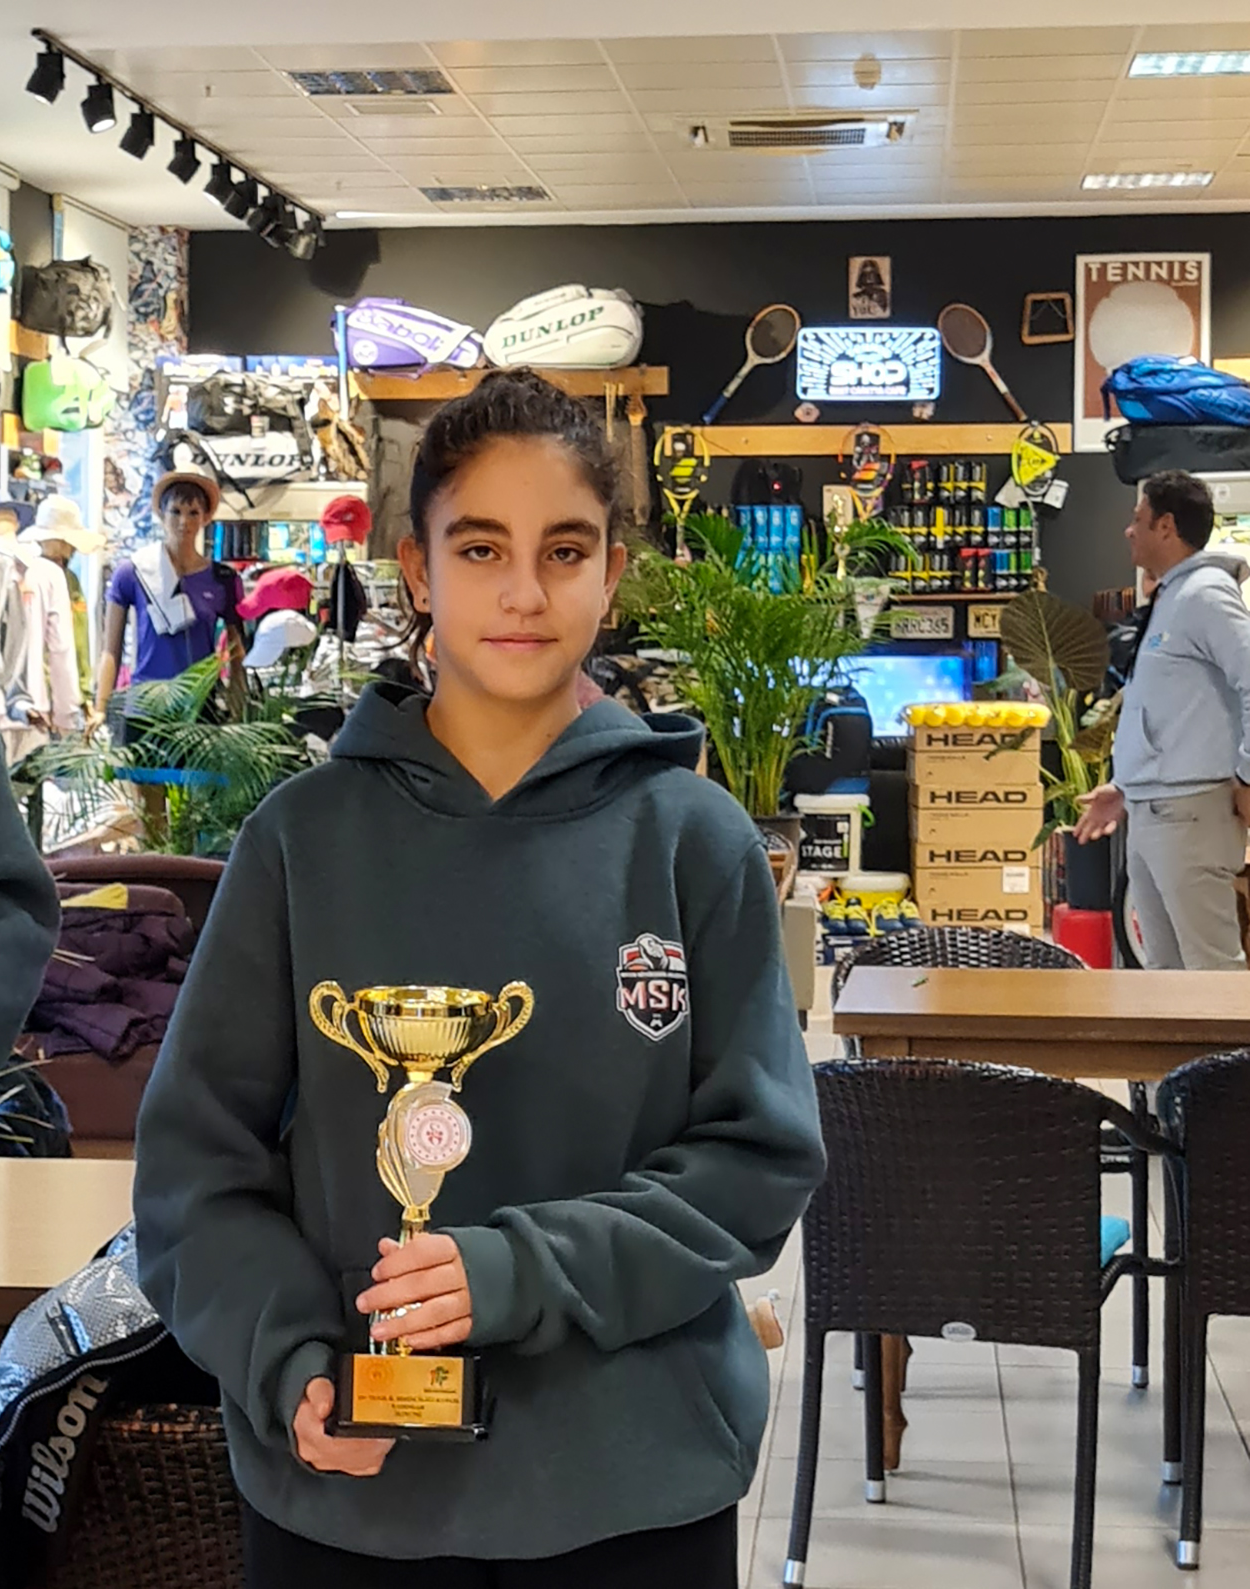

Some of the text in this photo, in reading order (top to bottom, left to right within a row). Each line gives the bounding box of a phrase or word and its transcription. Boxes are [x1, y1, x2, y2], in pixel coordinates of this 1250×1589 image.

[1088, 261, 1199, 281] TENNIS
[502, 306, 604, 349] DUNLOP
[830, 360, 908, 386] SHOP
[930, 791, 1027, 804] HEAD
[801, 845, 842, 858] STAGE
[929, 850, 1027, 862] HEAD
[931, 909, 1028, 921] HEAD
[621, 980, 686, 1012] MSK
[22, 1374, 108, 1533] Wilson
